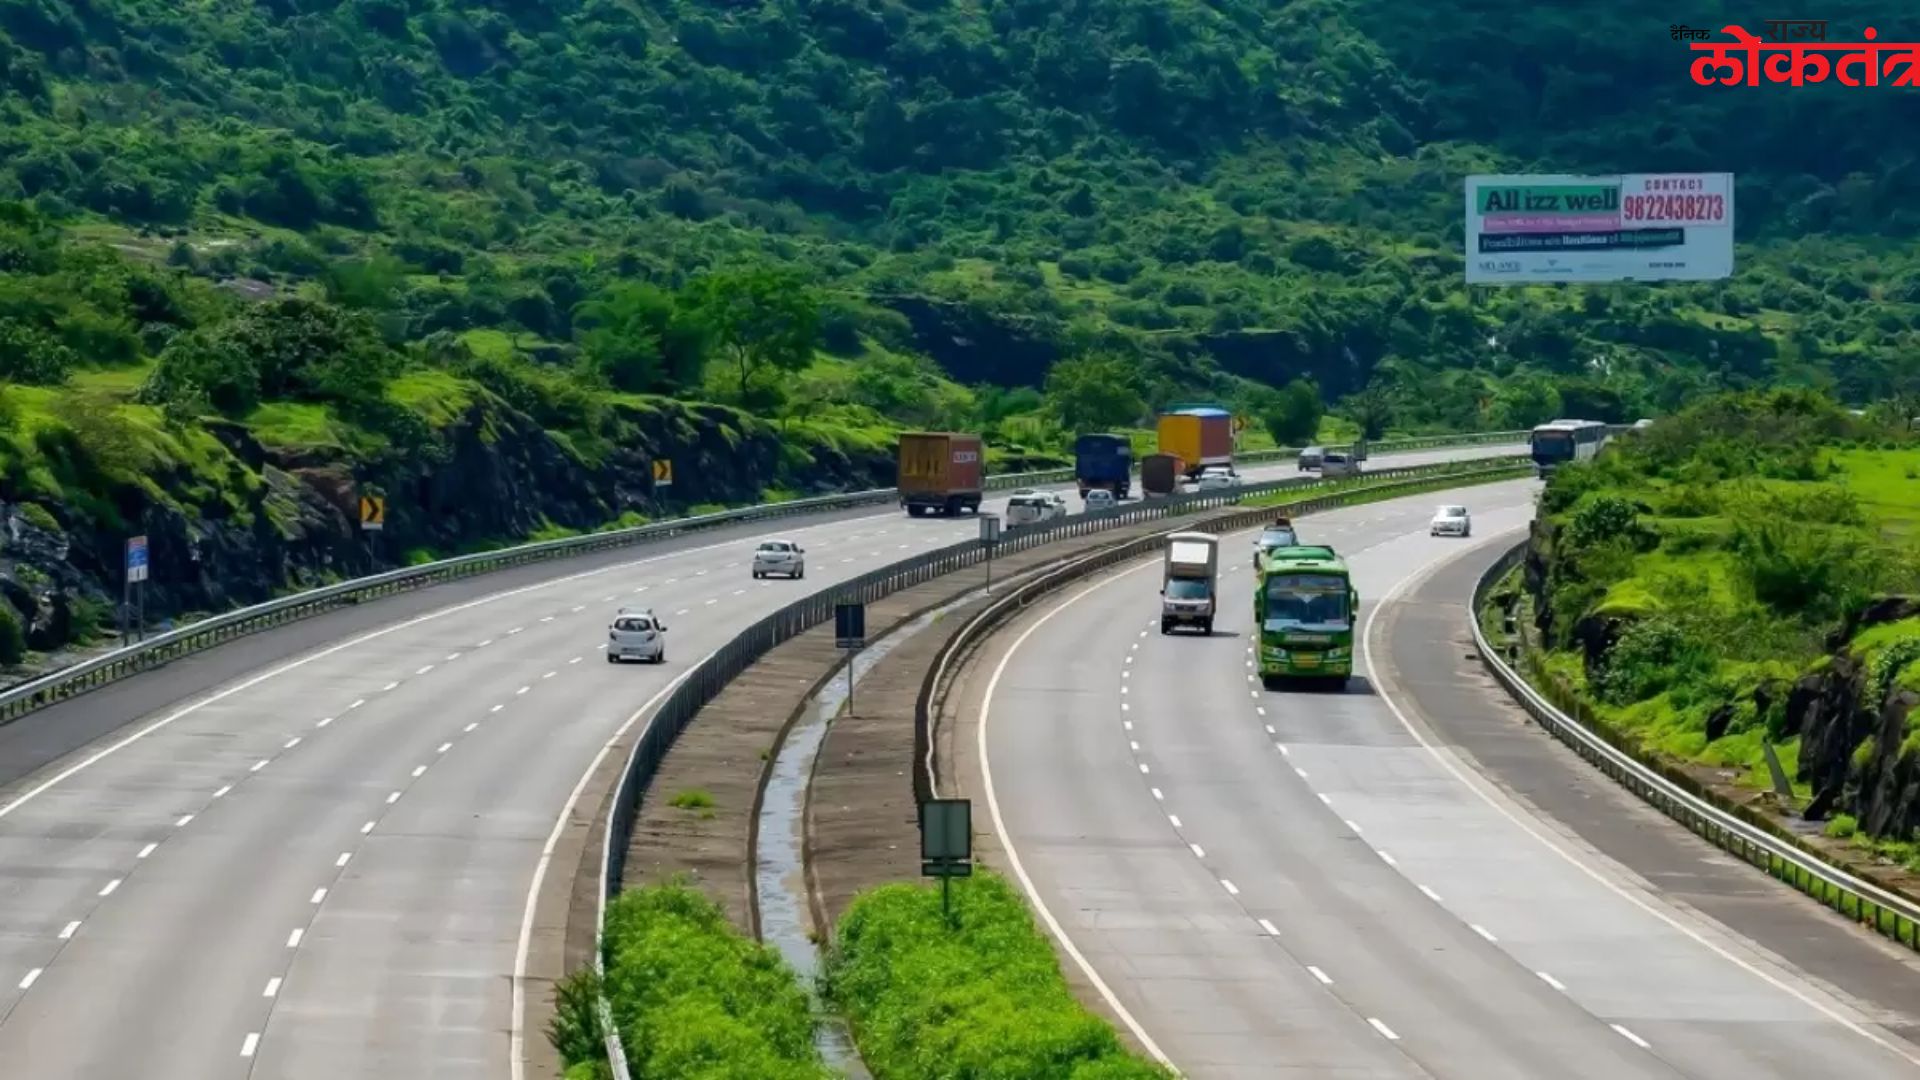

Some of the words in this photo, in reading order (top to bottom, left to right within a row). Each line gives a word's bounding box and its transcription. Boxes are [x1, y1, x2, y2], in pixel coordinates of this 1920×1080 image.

[1645, 179, 1703, 191] CONTACT
[1485, 189, 1519, 211] All
[1525, 189, 1560, 211] izz
[1565, 188, 1618, 210] well
[1623, 194, 1723, 220] 9822438273
